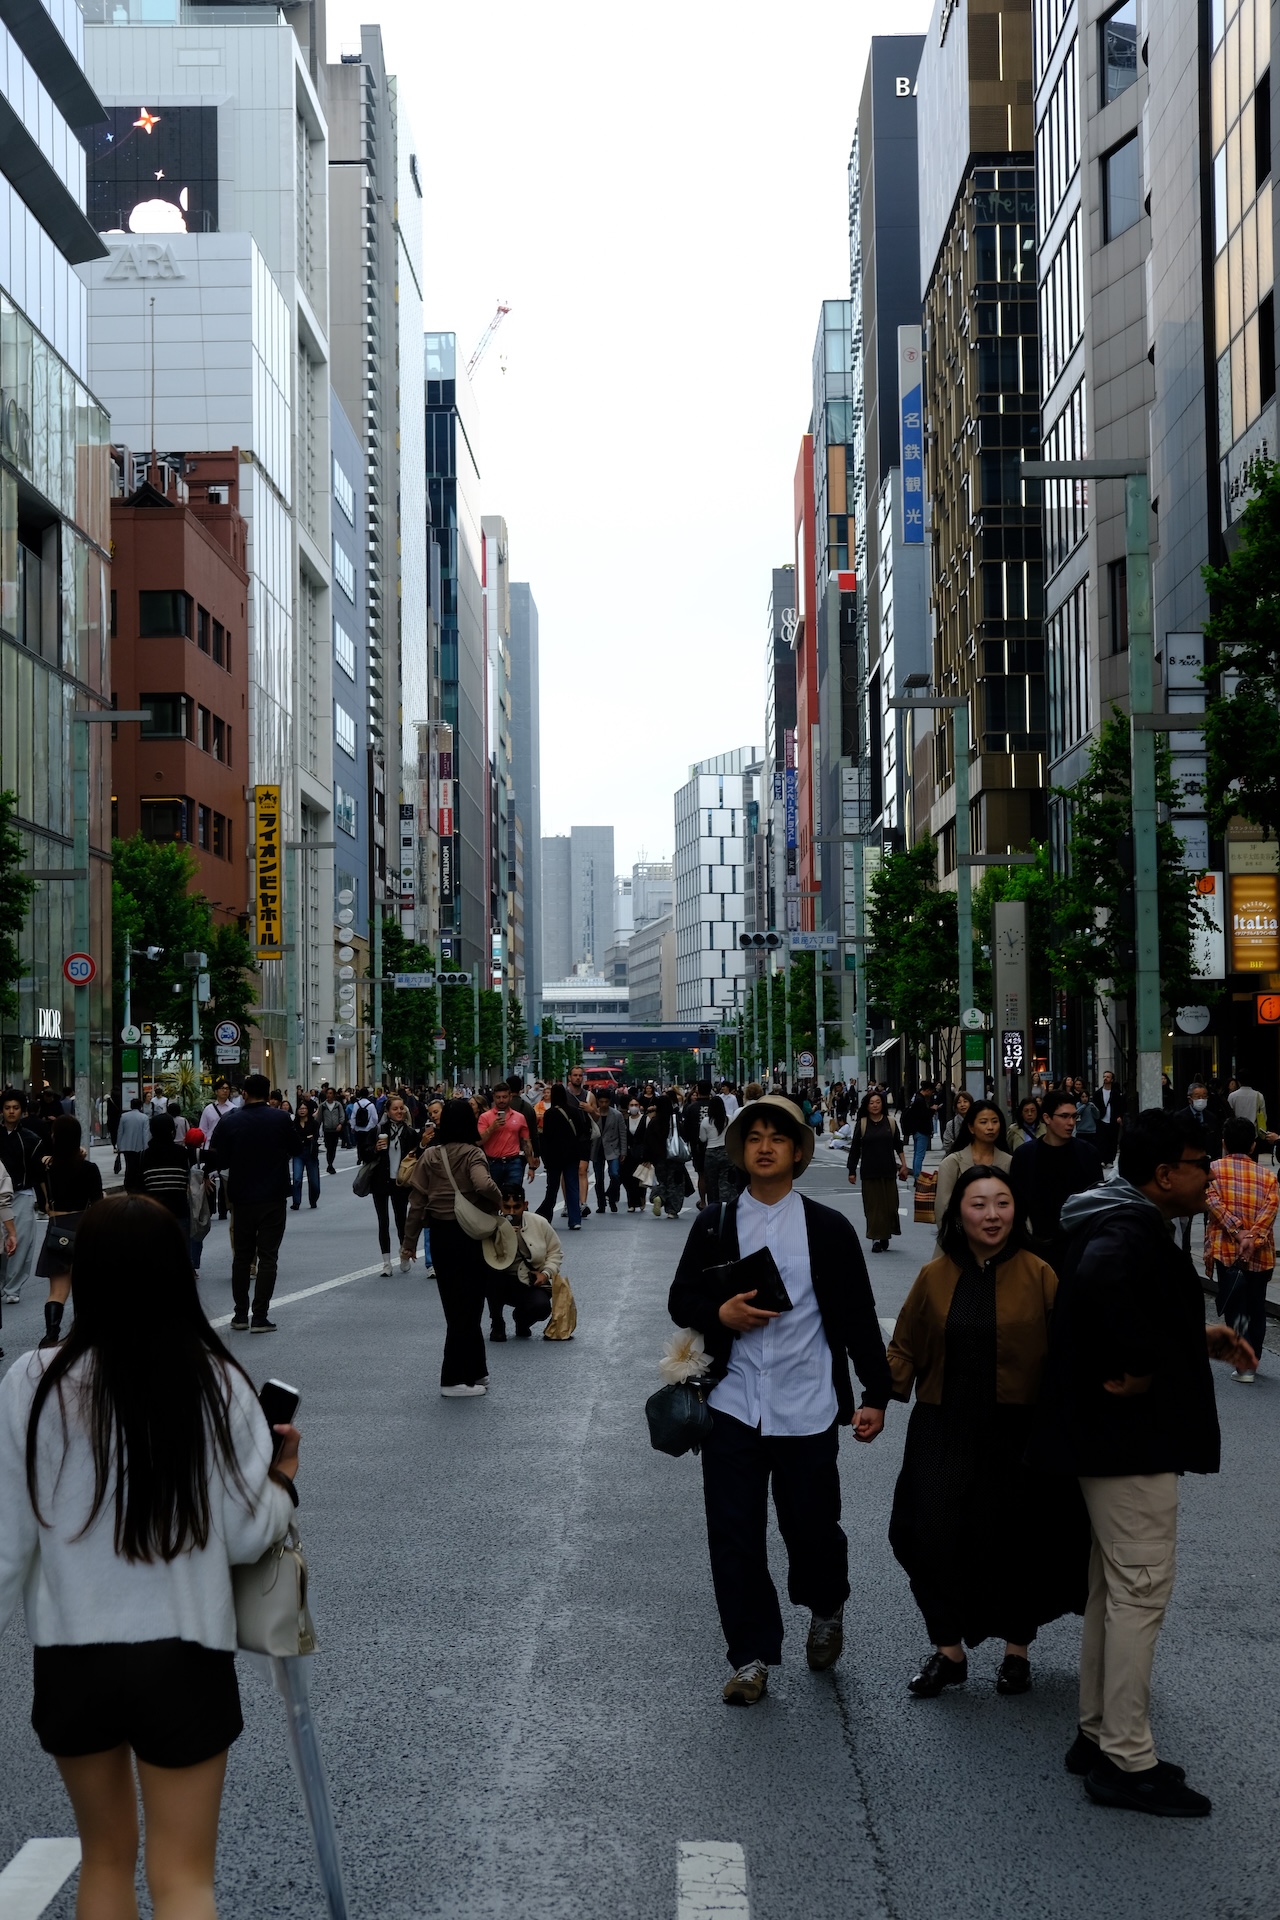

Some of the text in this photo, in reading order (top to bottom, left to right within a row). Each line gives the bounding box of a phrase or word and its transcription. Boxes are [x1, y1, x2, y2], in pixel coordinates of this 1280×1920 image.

[104, 244, 185, 280] ZARA
[904, 412, 922, 525] 名鉄観光
[1169, 656, 1176, 665] 8
[259, 813, 278, 945] ライオンビヤホール
[1240, 900, 1273, 912] TRATTORIA
[1233, 914, 1279, 930] ItaLia
[792, 936, 834, 944] 銀座六丁目
[70, 962, 89, 976] 50
[971, 1010, 976, 1018] 5
[38, 1008, 61, 1039] DIOR
[128, 1028, 134, 1036] 6
[1006, 1045, 1022, 1056] 13
[1004, 1056, 1022, 1067] 57
